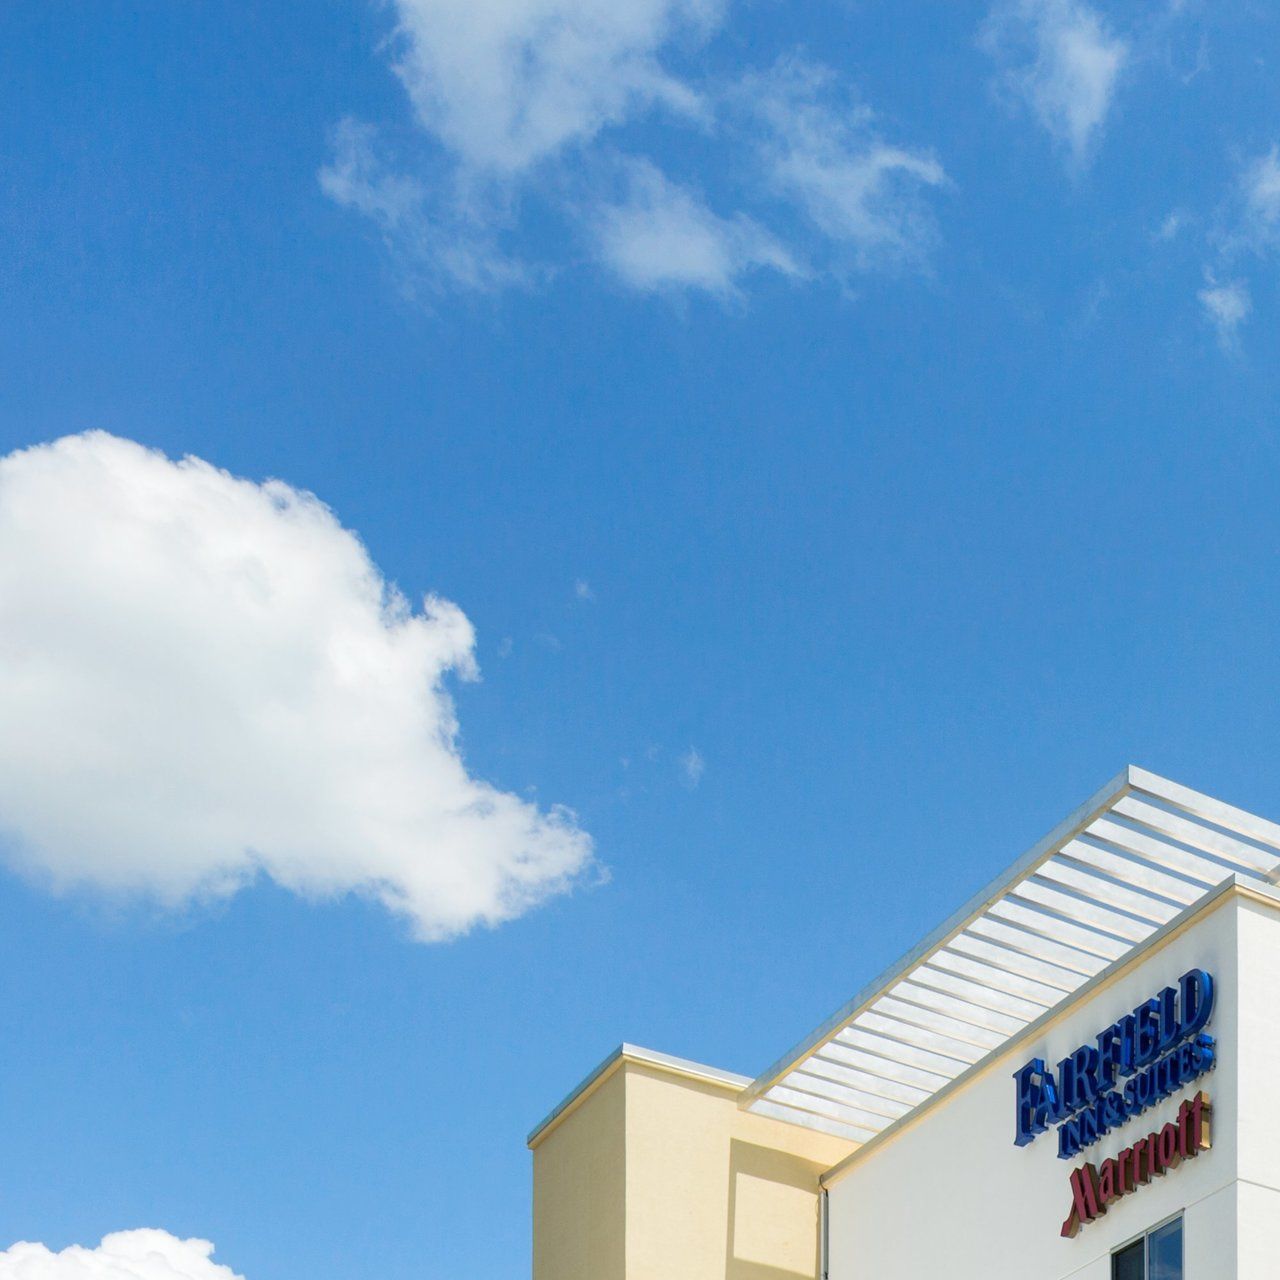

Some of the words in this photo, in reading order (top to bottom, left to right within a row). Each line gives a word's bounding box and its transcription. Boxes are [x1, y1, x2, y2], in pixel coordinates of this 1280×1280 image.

[1013, 968, 1214, 1147] FAIRFIELD
[1057, 1100, 1112, 1160] INN
[1103, 1091, 1130, 1128] &
[1124, 1033, 1216, 1116] SUITES
[1060, 1090, 1213, 1238] Marriott
